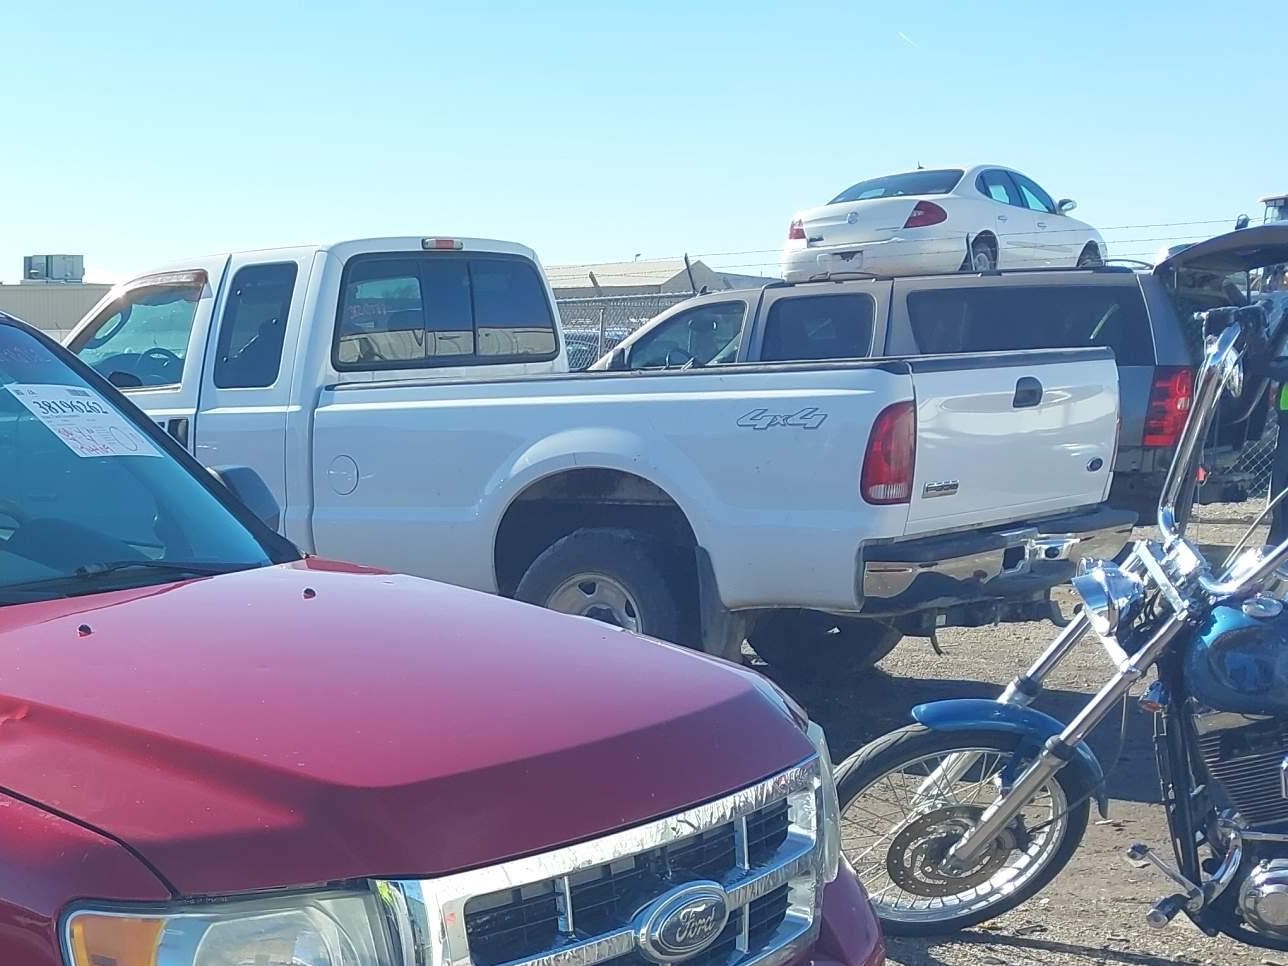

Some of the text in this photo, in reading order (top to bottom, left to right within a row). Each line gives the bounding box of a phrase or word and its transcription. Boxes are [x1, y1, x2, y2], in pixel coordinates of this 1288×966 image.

[32, 400, 109, 415] 38196262
[736, 407, 828, 430] 4x4
[675, 903, 716, 942] Ford
